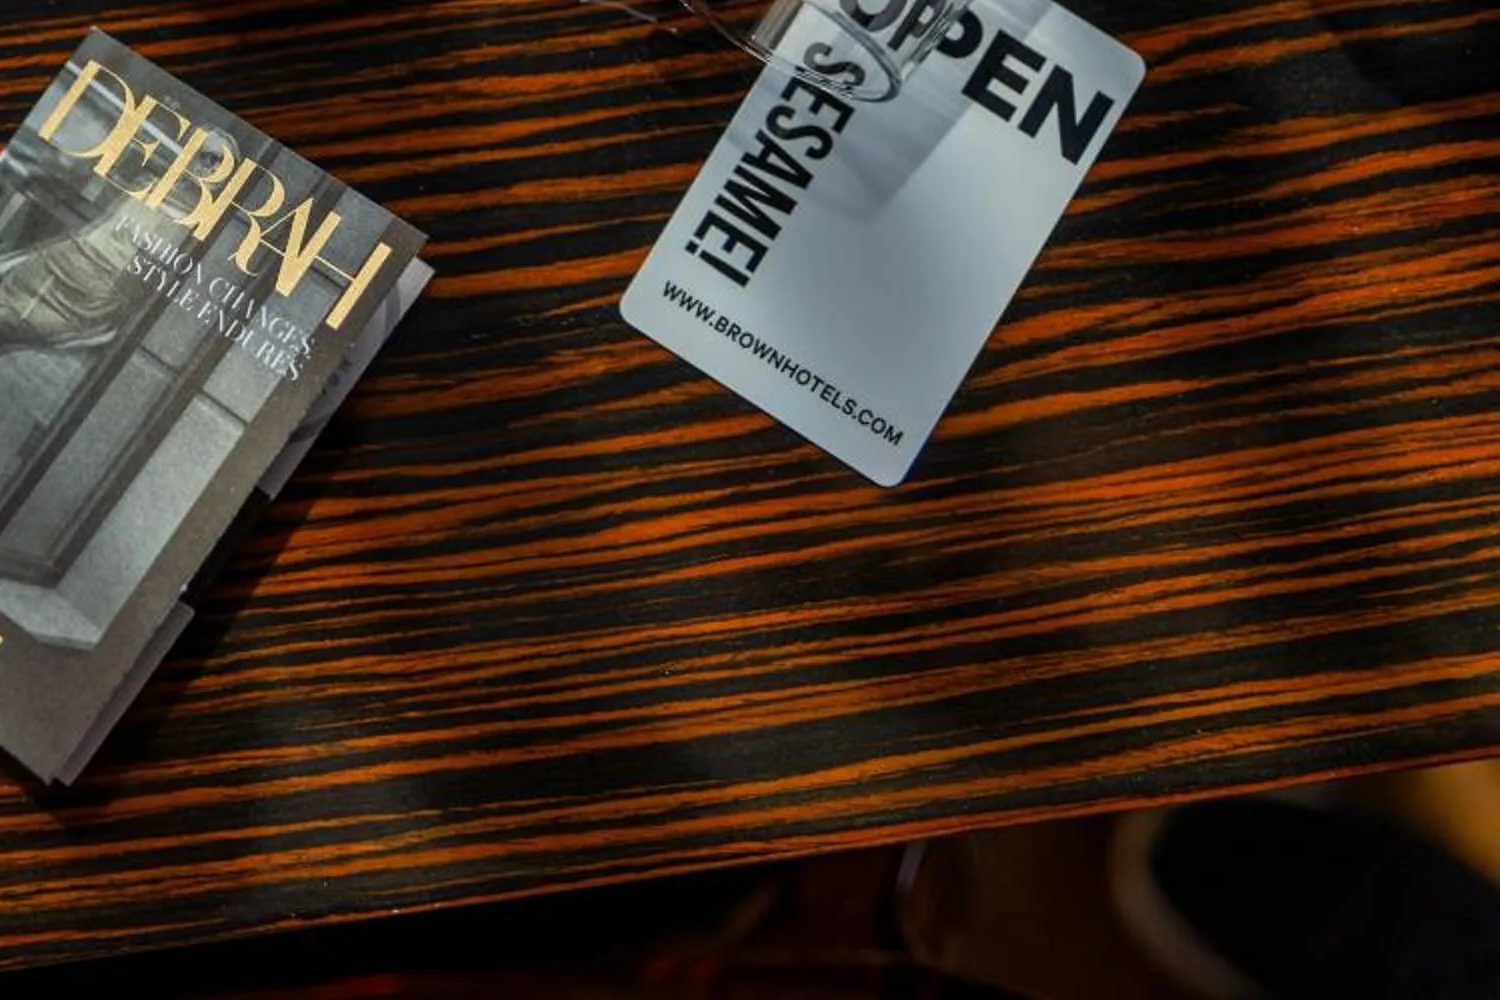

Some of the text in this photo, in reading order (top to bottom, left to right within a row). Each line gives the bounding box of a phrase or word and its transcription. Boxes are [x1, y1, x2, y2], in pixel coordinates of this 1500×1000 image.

[684, 40, 866, 287] SESAME!
[126, 252, 200, 313] STYLE
[663, 280, 904, 447] WWW.BROWNHOTELS.COM
